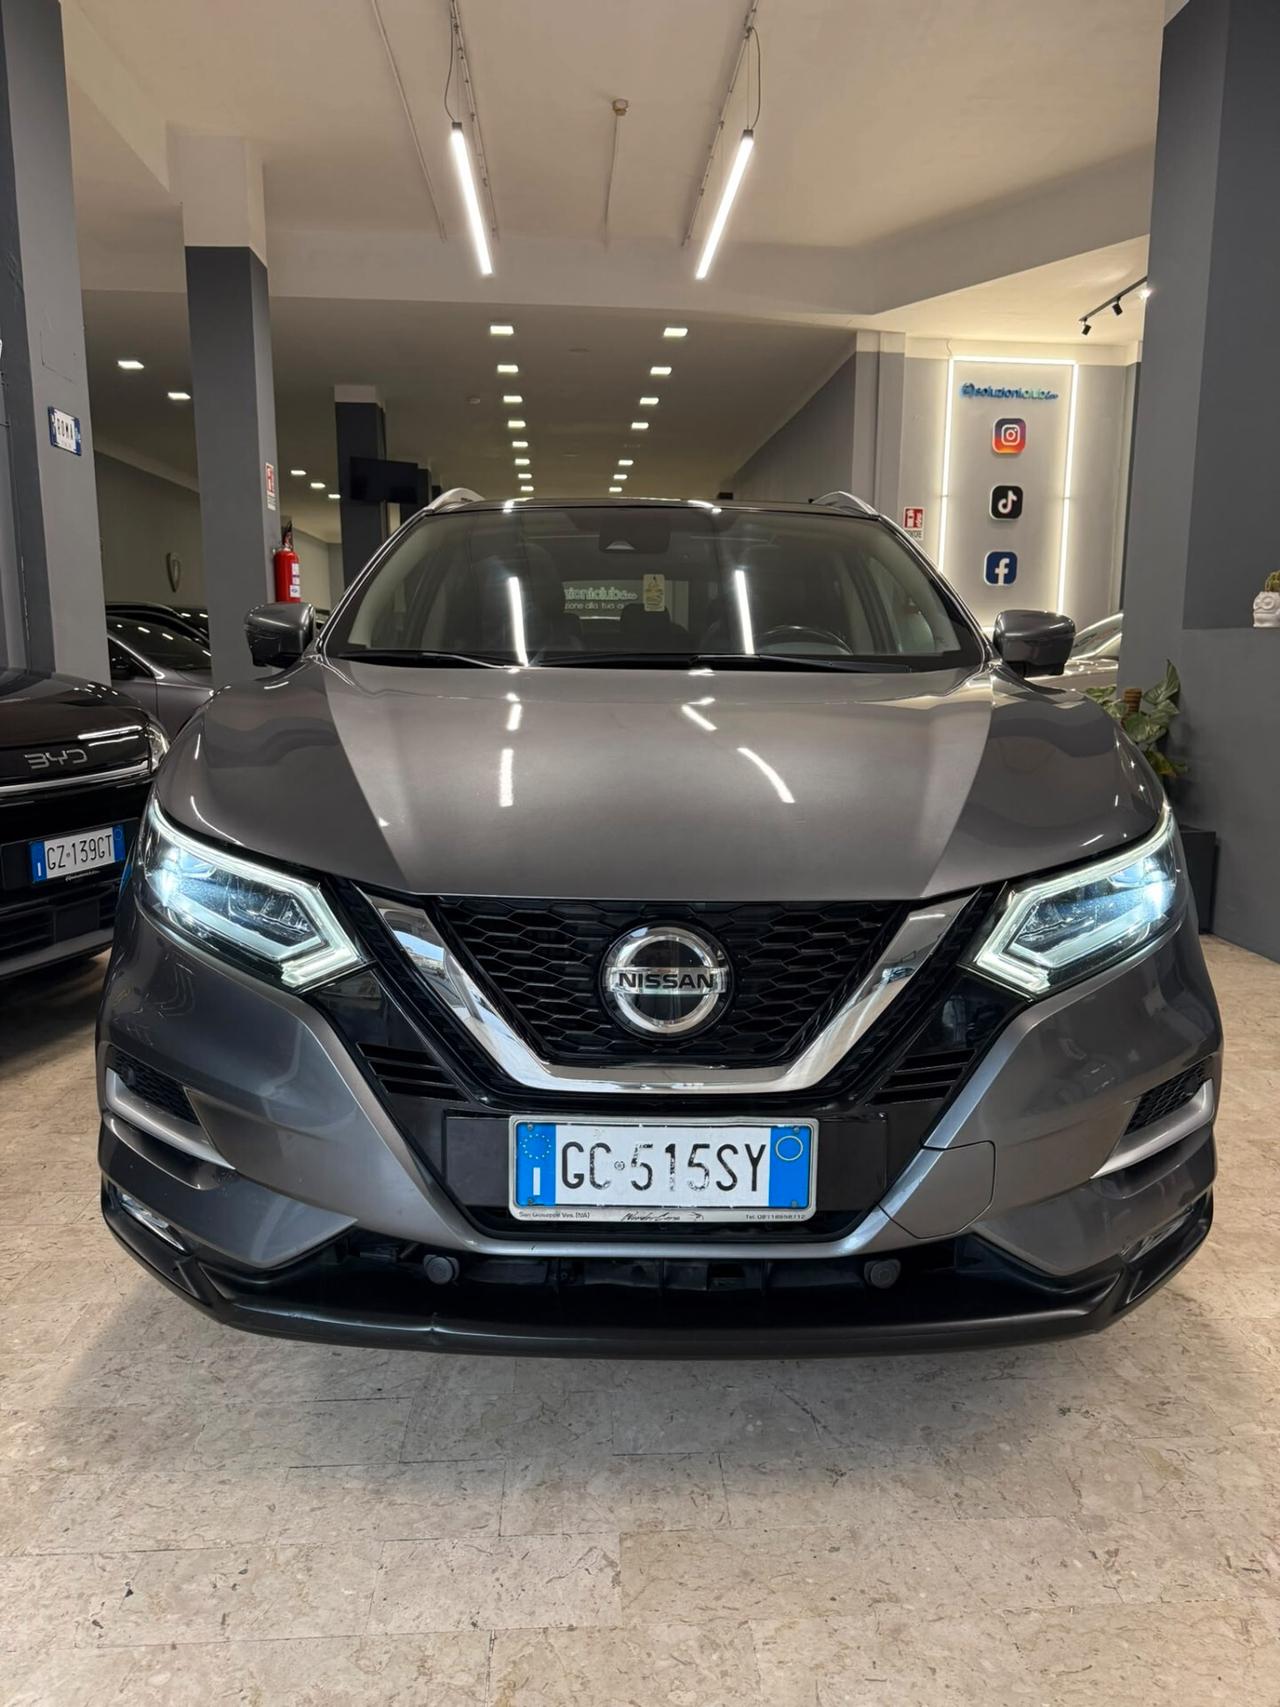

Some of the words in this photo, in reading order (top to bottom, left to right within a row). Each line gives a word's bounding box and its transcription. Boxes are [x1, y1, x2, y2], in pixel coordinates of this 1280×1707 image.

[25, 748, 88, 770] BYD
[46, 845, 66, 870] GZ
[71, 834, 112, 865] 139GT
[619, 972, 715, 989] NISSAN
[561, 1141, 612, 1190] GC
[630, 1143, 767, 1192] 515SY
